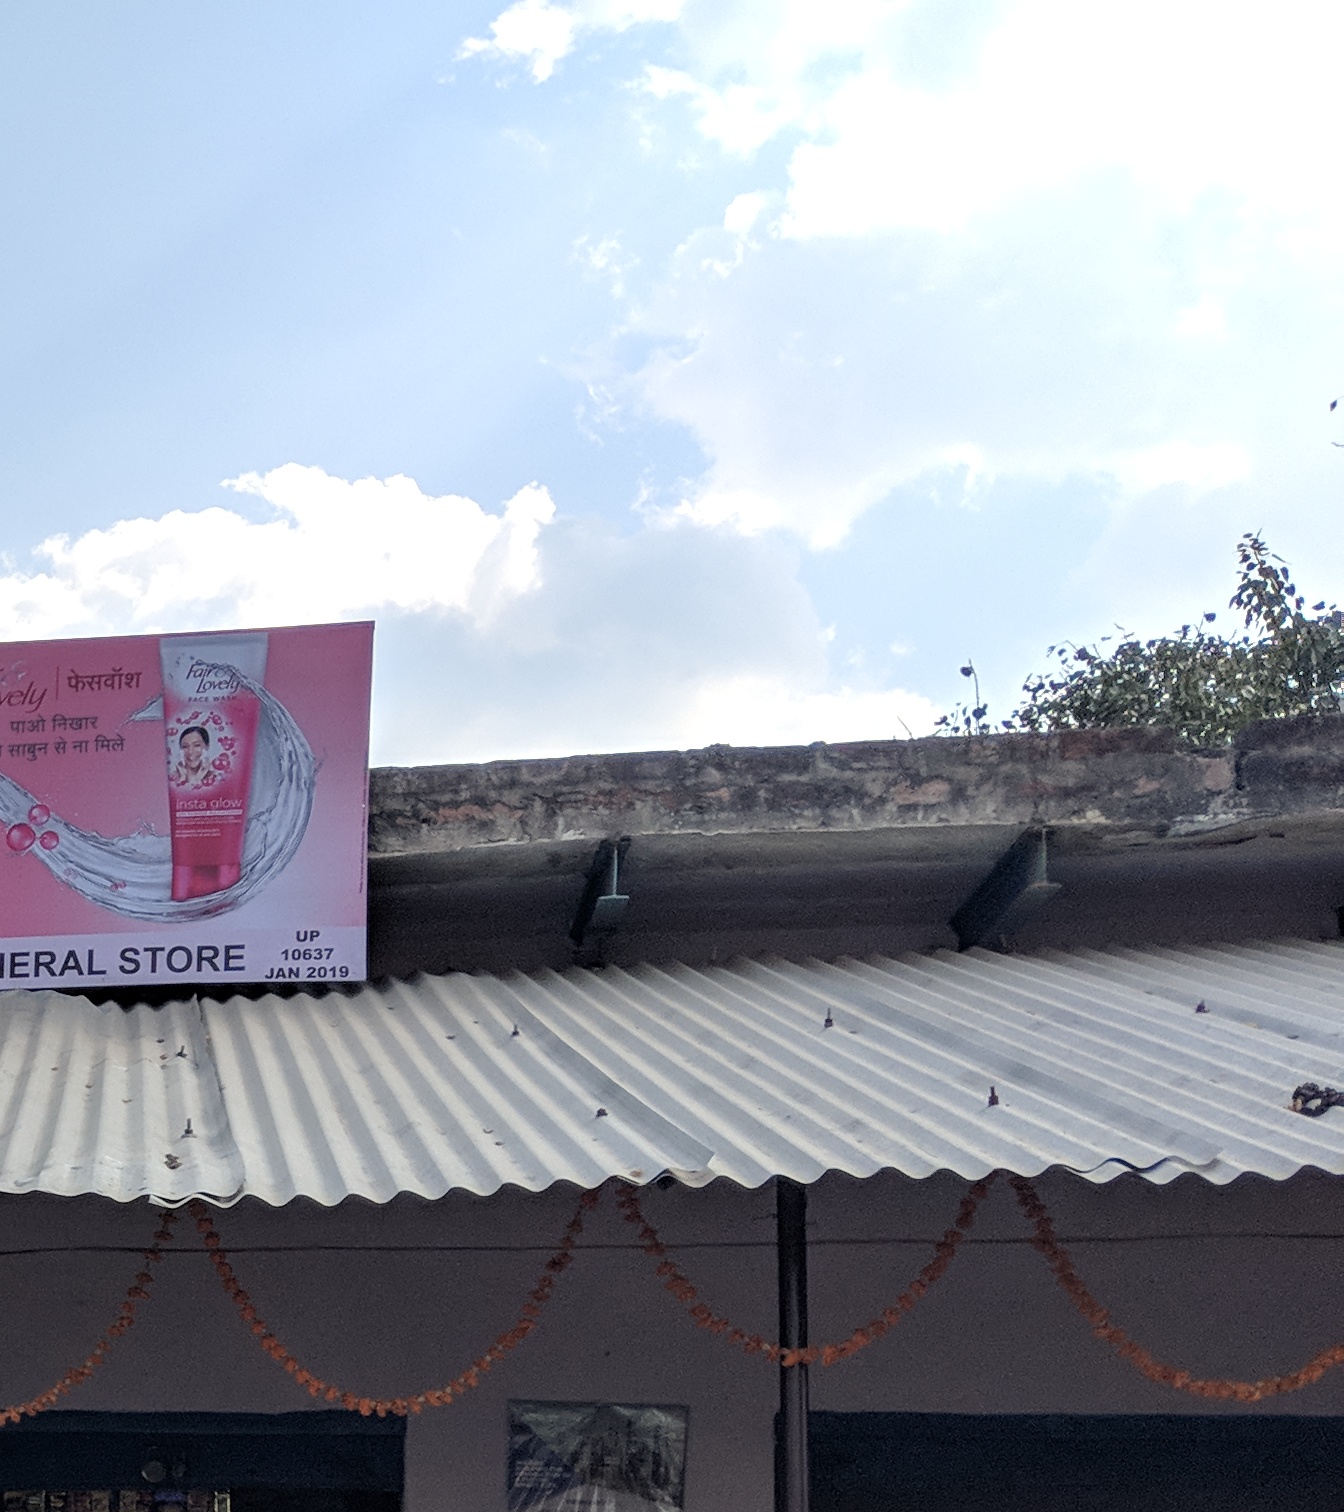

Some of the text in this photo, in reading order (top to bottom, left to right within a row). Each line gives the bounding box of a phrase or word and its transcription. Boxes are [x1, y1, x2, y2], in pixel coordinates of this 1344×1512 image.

[67, 667, 142, 692] फेसवॉश
[196, 675, 240, 694] Lovely
[10, 714, 98, 733] पाओ निखार
[8, 742, 48, 761] साबुन
[54, 736, 66, 754] से
[72, 740, 89, 753] ना
[95, 733, 126, 752] मिले
[295, 930, 320, 943] UP
[118, 944, 247, 974] STORE
[280, 947, 334, 961] 10637
[264, 964, 349, 980] JAN 2019
